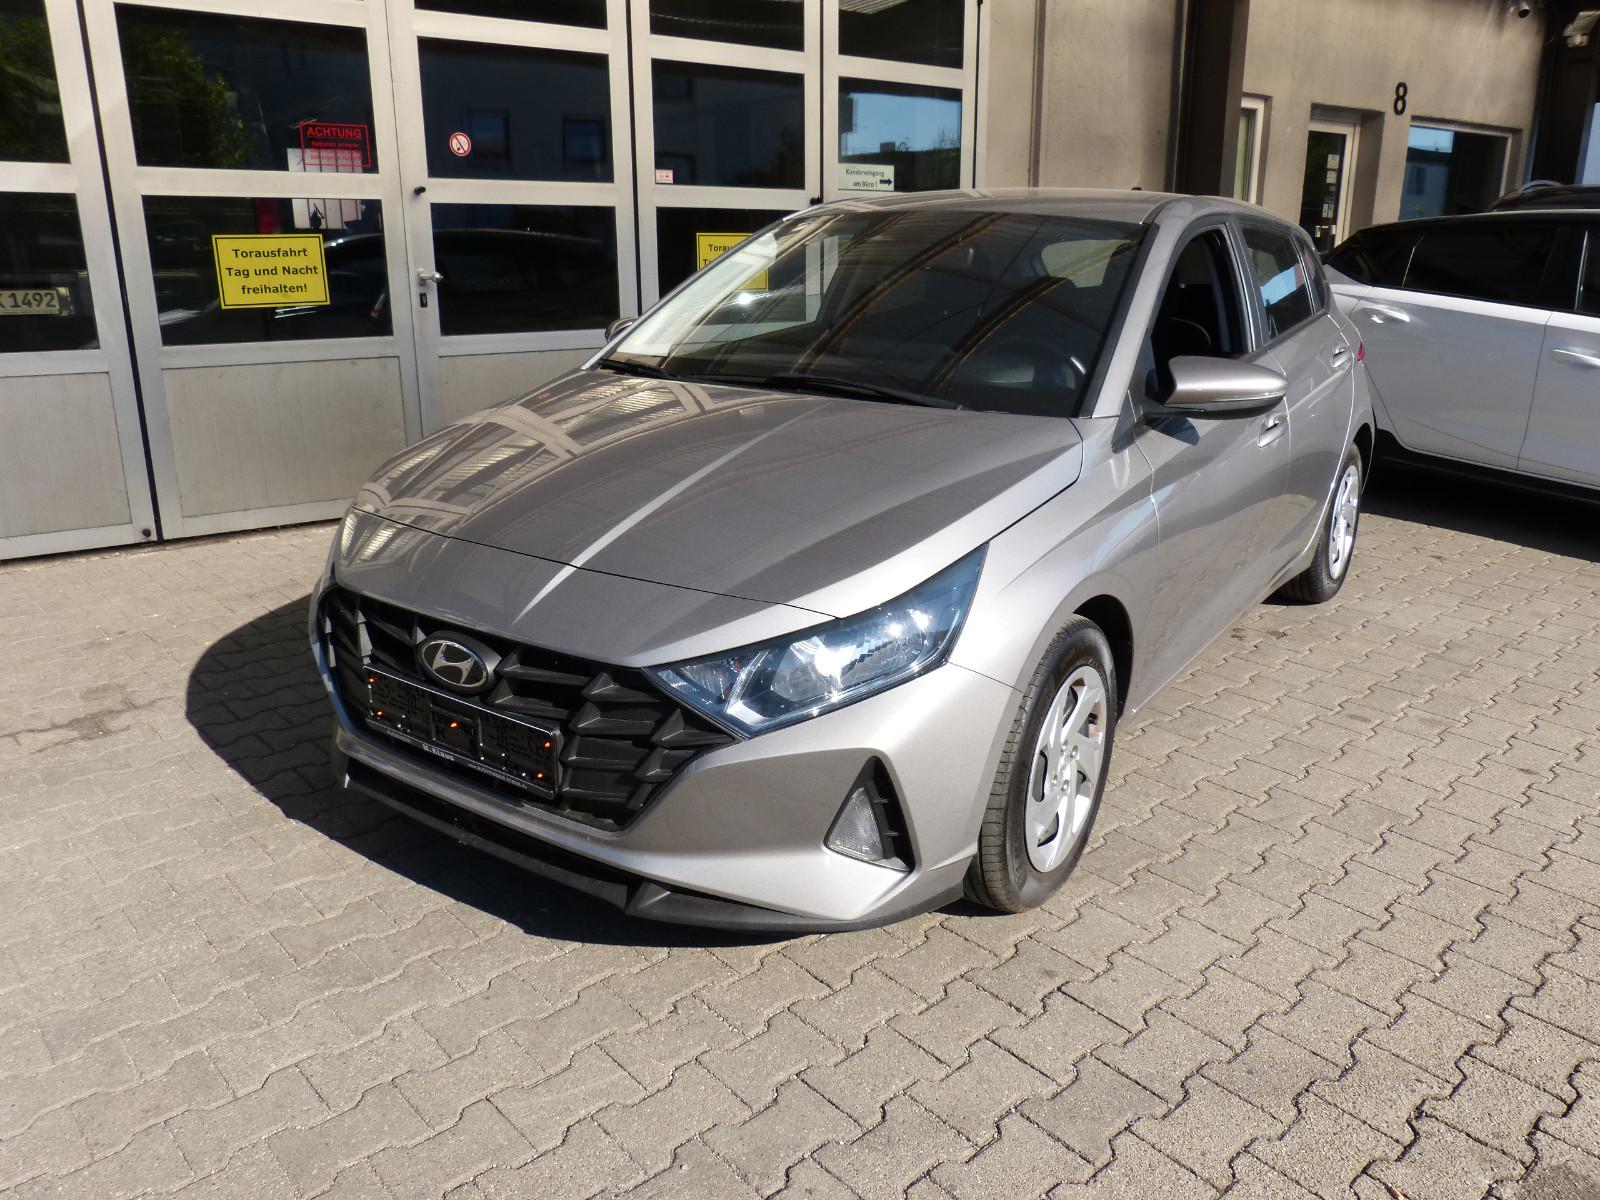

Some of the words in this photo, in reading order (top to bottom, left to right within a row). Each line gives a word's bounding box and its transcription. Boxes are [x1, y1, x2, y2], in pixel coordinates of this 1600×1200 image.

[1393, 82, 1408, 116] 8
[307, 127, 362, 138] ACHTUNG
[232, 247, 308, 258] Torausfahrt
[225, 267, 250, 278] Tag
[254, 266, 278, 276] und
[282, 265, 319, 275] Nacht
[241, 283, 308, 294] freihalten!
